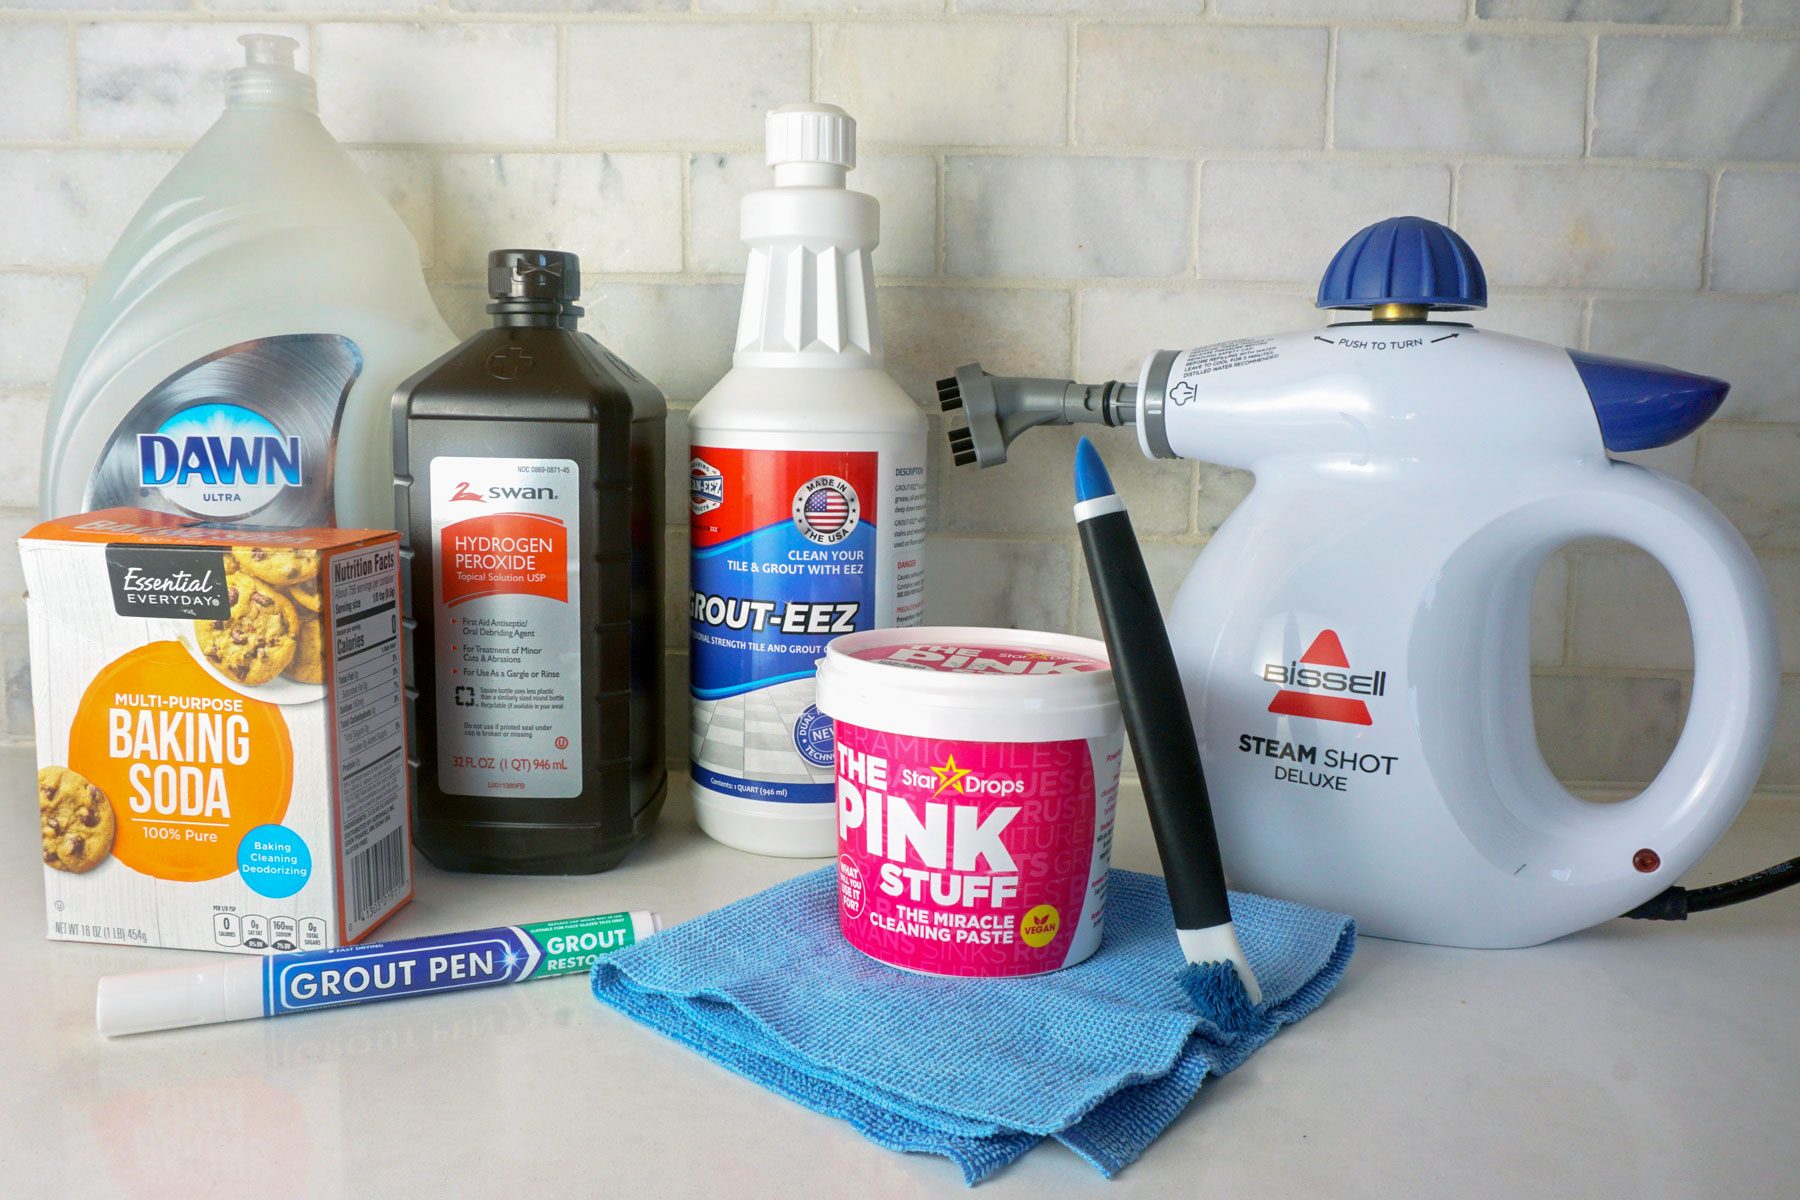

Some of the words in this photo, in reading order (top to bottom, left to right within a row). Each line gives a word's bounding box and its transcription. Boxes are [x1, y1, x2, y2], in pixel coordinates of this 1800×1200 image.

[1338, 338, 1365, 350] PUSH
[1370, 341, 1387, 350] TO
[1391, 338, 1423, 350] TURN
[1209, 352, 1238, 362] REFILLING
[1183, 367, 1211, 378] DISTILLED
[1213, 363, 1232, 372] WATER
[1233, 353, 1280, 367] RECOMMENDED
[138, 434, 302, 487] DAWN
[806, 479, 834, 492] MADE
[837, 482, 847, 492] IN
[203, 493, 242, 502] ULTRA
[805, 528, 824, 543] THE
[828, 529, 849, 543] USA
[456, 536, 553, 553] HYDROGEN
[456, 554, 536, 570] PEROXIDE
[788, 550, 828, 561] CLEAN
[832, 550, 864, 561] YOUR
[335, 558, 373, 583] Nutrition
[374, 552, 394, 572] Facts
[727, 560, 748, 571] TILE
[751, 563, 759, 572] &
[762, 564, 804, 574] GROUT
[808, 565, 840, 575] WITH
[844, 564, 864, 574] EEZ
[898, 559, 917, 569] DANGER
[123, 567, 213, 593] Essential
[457, 571, 485, 582] Topical
[488, 573, 524, 583] Solution
[527, 574, 546, 582] USP
[127, 593, 213, 606] EVERYDAY
[335, 601, 352, 614] Serving
[491, 619, 528, 629] Antiseptic/
[337, 633, 365, 655] Calories
[392, 614, 397, 634] 0
[480, 628, 513, 638] Debriding
[514, 630, 535, 638] Agent
[463, 645, 474, 653] For
[476, 646, 510, 654] Treatment
[711, 637, 746, 650] STRENGTH
[748, 642, 765, 652] TILE
[767, 644, 787, 653] AND
[789, 645, 821, 654] GROUT
[904, 645, 983, 657] THE
[464, 654, 479, 662] Cuts
[488, 655, 521, 663] Abrasions
[998, 652, 1027, 660] Star
[464, 668, 475, 676] For
[477, 669, 489, 677] Use
[507, 670, 529, 679] Gargle
[480, 687, 497, 695] Square
[115, 693, 243, 712] MULTI-PURPOSE
[800, 714, 815, 736] DUAL
[109, 708, 250, 766] BAKING
[805, 745, 834, 761] TECHN
[1238, 734, 1317, 765] STEAM
[1323, 749, 1399, 776] SHOT
[453, 756, 464, 768] 32
[466, 757, 477, 768] FL
[478, 757, 496, 769] OZ
[510, 758, 531, 772] QT)
[533, 759, 551, 770] 946
[552, 759, 568, 770] mL
[838, 741, 888, 791] THE
[902, 768, 938, 789] Star
[966, 776, 1025, 797] Drops
[1275, 766, 1348, 792] DELUXE
[129, 763, 231, 818] SODA
[710, 777, 733, 790] Contents:
[737, 784, 758, 796] QUART
[759, 786, 775, 797] (946
[776, 787, 788, 797] ml)
[838, 775, 1022, 872] PINK
[142, 826, 180, 841] 100%
[186, 829, 218, 842] Pure
[254, 841, 291, 853] Baking
[250, 853, 298, 865] Cleaning
[242, 864, 307, 877] Deodorizing
[841, 862, 858, 879] WHAT
[850, 878, 862, 890] YOU
[879, 862, 1019, 908] STUFF
[853, 889, 860, 900] IT
[843, 894, 859, 912] FOR?
[223, 917, 230, 930] 0
[896, 904, 929, 924] THE
[934, 911, 1015, 929] MIRACLE
[250, 920, 259, 930] 0g
[273, 921, 294, 931] 160mg
[308, 922, 317, 932] 0g
[869, 911, 951, 943] CLEANING
[956, 930, 1014, 944] PASTE
[1024, 923, 1056, 935] VEGAN
[55, 922, 67, 934] NET
[68, 923, 79, 935] WT
[81, 924, 91, 937] 16
[92, 925, 101, 937] OZ
[103, 927, 111, 940] (1
[113, 927, 125, 941] LB)
[127, 929, 147, 944] 454g
[355, 943, 384, 951] DRYING
[547, 928, 627, 955] GROUT
[547, 954, 597, 971] RESTO
[290, 961, 413, 1000] GROUT
[429, 951, 494, 982] PEN
